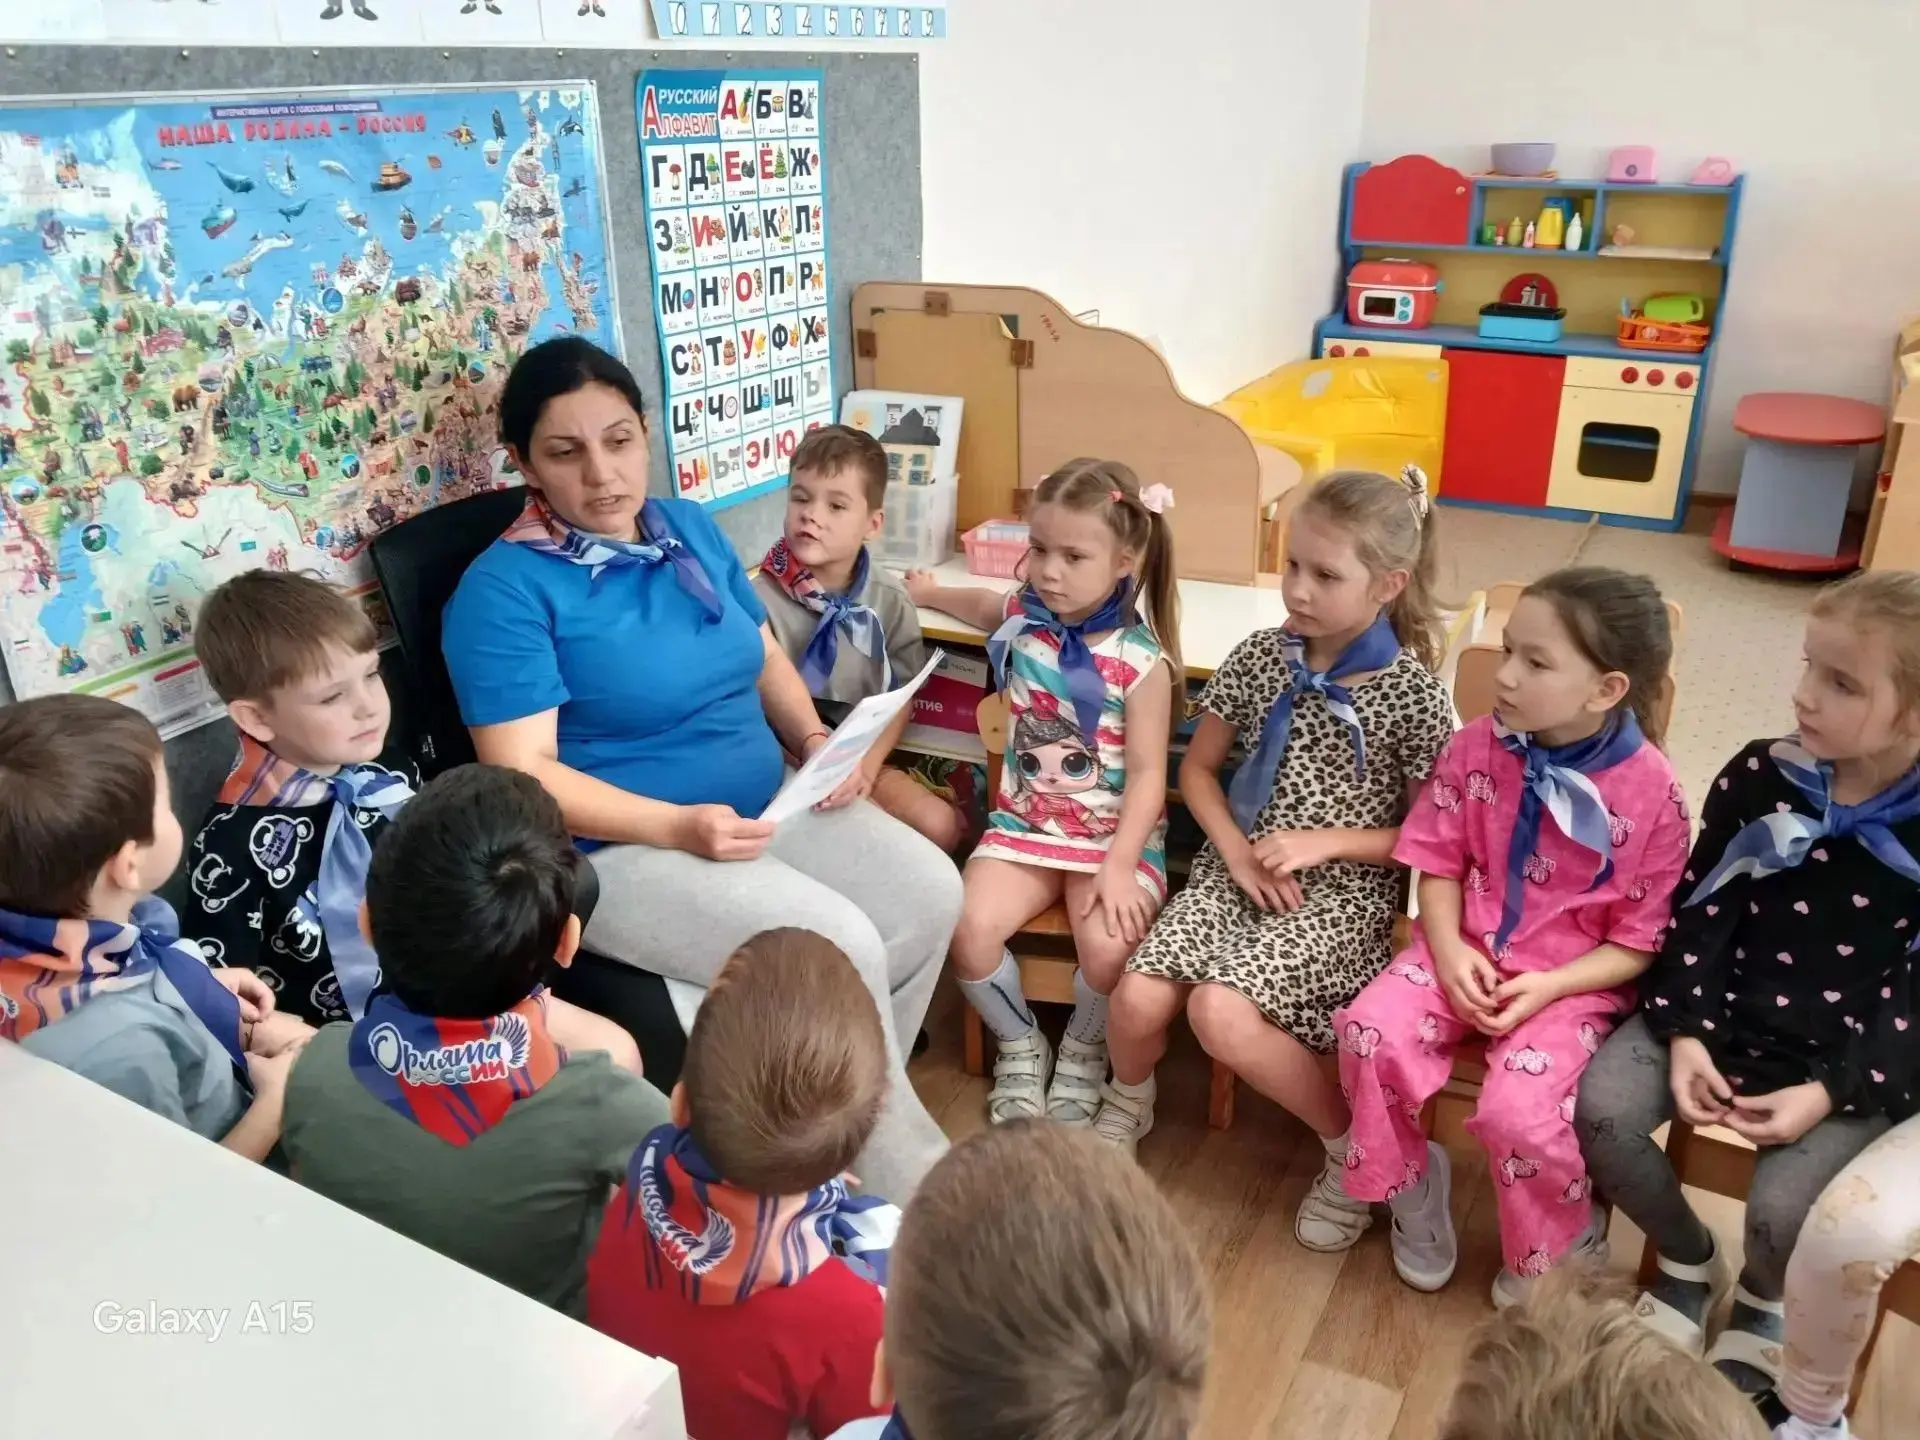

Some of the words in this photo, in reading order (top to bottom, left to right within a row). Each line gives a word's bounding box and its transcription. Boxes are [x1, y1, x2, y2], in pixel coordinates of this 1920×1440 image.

[675, 2, 686, 35] 0
[711, 3, 720, 34] 1
[740, 5, 751, 35] 2
[772, 5, 783, 35] 3
[801, 6, 812, 35] 4
[828, 8, 839, 35] 5
[855, 8, 864, 36] 6
[878, 8, 888, 36] 7
[902, 9, 911, 36] 8
[642, 86, 718, 138] АЛФАВИТ
[658, 85, 718, 105] РУССКИЙ
[720, 89, 738, 120] А
[756, 89, 772, 119] Б
[789, 89, 804, 119] В
[158, 123, 233, 147] НАША
[244, 119, 333, 142] РОДИНА
[357, 113, 426, 136] РОССИЯ
[652, 155, 667, 188] Г
[689, 153, 709, 191] Д
[725, 151, 742, 182] Е
[759, 142, 774, 180] Ё
[790, 147, 811, 177] Ж
[654, 219, 673, 251] З
[692, 215, 713, 248] И
[729, 204, 748, 243] Й
[763, 208, 780, 238] К
[795, 205, 811, 235] Л
[661, 282, 682, 315] М
[700, 276, 719, 309] Н
[735, 271, 753, 302] О
[769, 265, 785, 296] П
[800, 262, 813, 290] Р
[671, 344, 689, 376] С
[706, 336, 722, 366] Т
[741, 329, 755, 359] У
[772, 323, 788, 350] Ф
[802, 315, 819, 345] Х
[673, 402, 693, 436] Ц
[708, 393, 724, 421] Ч
[743, 384, 762, 415] Ш
[774, 376, 794, 407] Щ
[803, 371, 820, 397] Ъ
[678, 458, 700, 492] Ы
[712, 452, 729, 480] Ь
[746, 441, 761, 469] Э
[775, 429, 796, 459] Ю
[370, 1025, 503, 1079] Орлята
